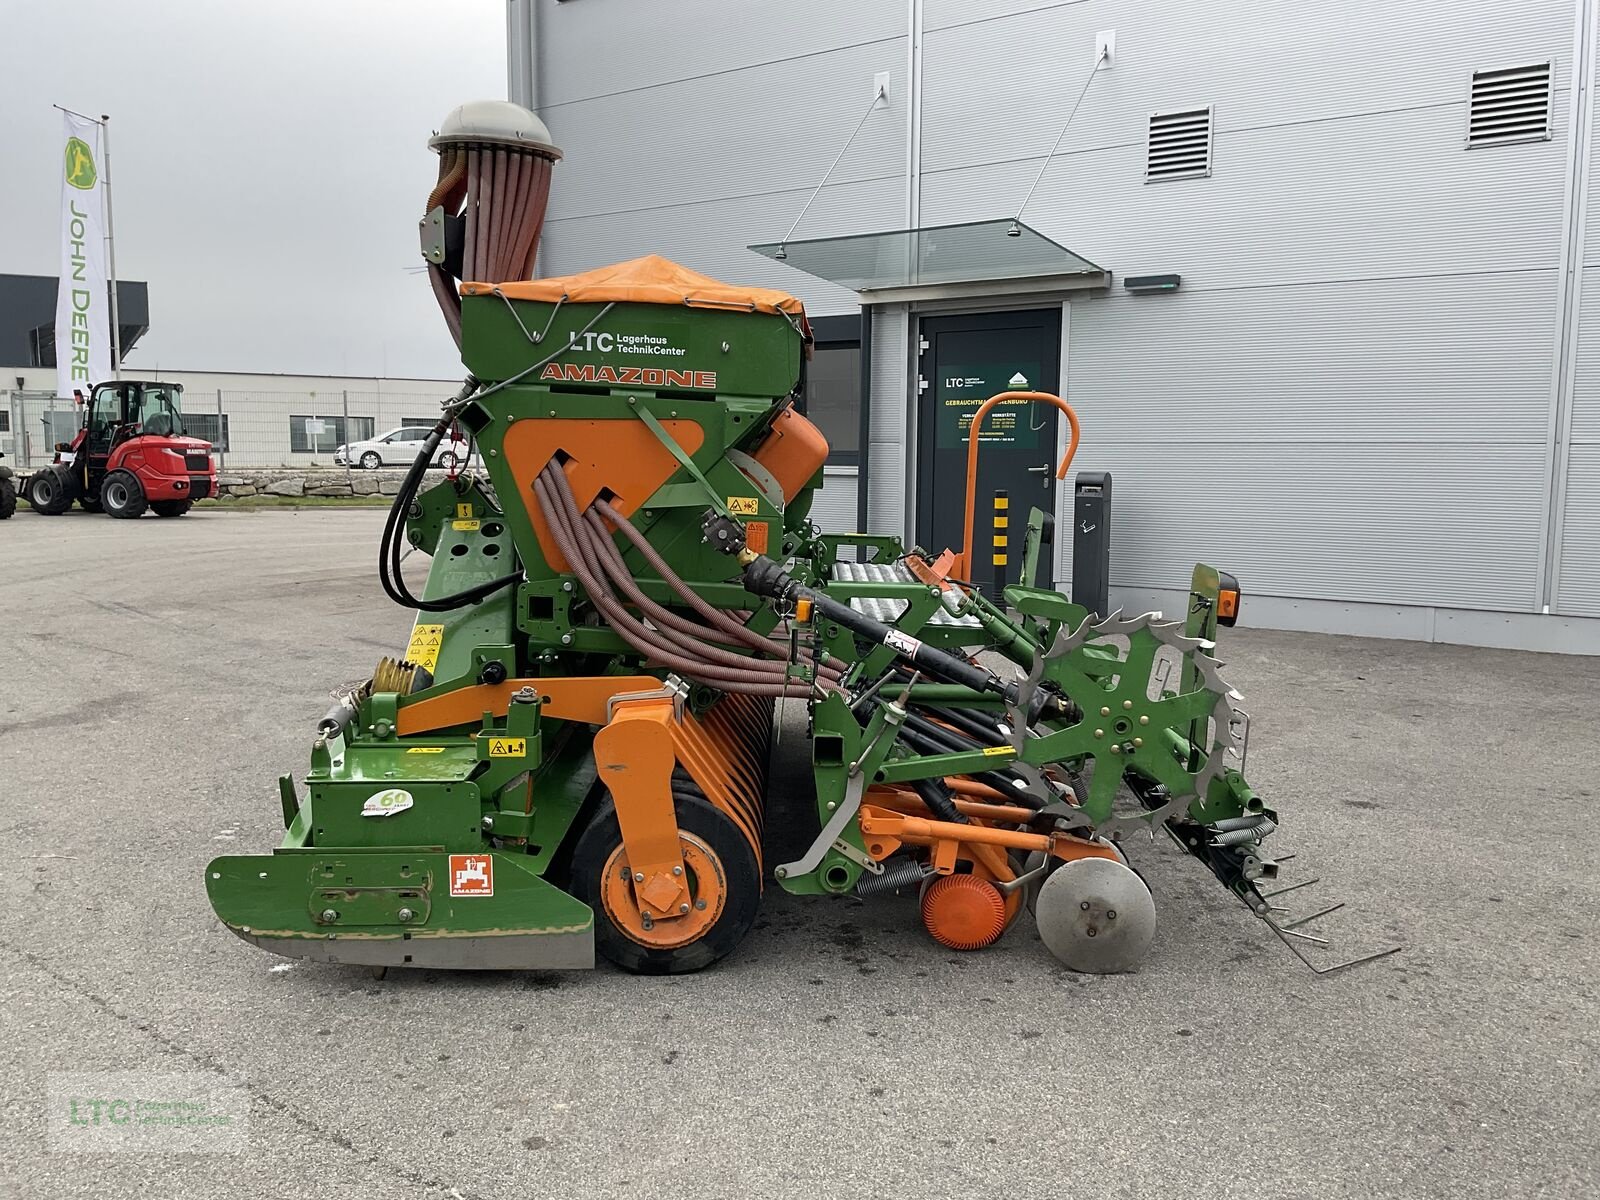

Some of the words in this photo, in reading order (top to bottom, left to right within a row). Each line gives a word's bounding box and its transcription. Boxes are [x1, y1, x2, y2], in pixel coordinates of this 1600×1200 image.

[70, 199, 88, 281] JOHN
[71, 288, 91, 382] DEERE
[569, 331, 613, 353] LTC
[616, 333, 668, 345] Lagerhaus
[616, 344, 686, 356] TechnikCenter
[540, 362, 717, 389] AMAZONE
[945, 378, 964, 388] LTC
[380, 791, 408, 807] 60
